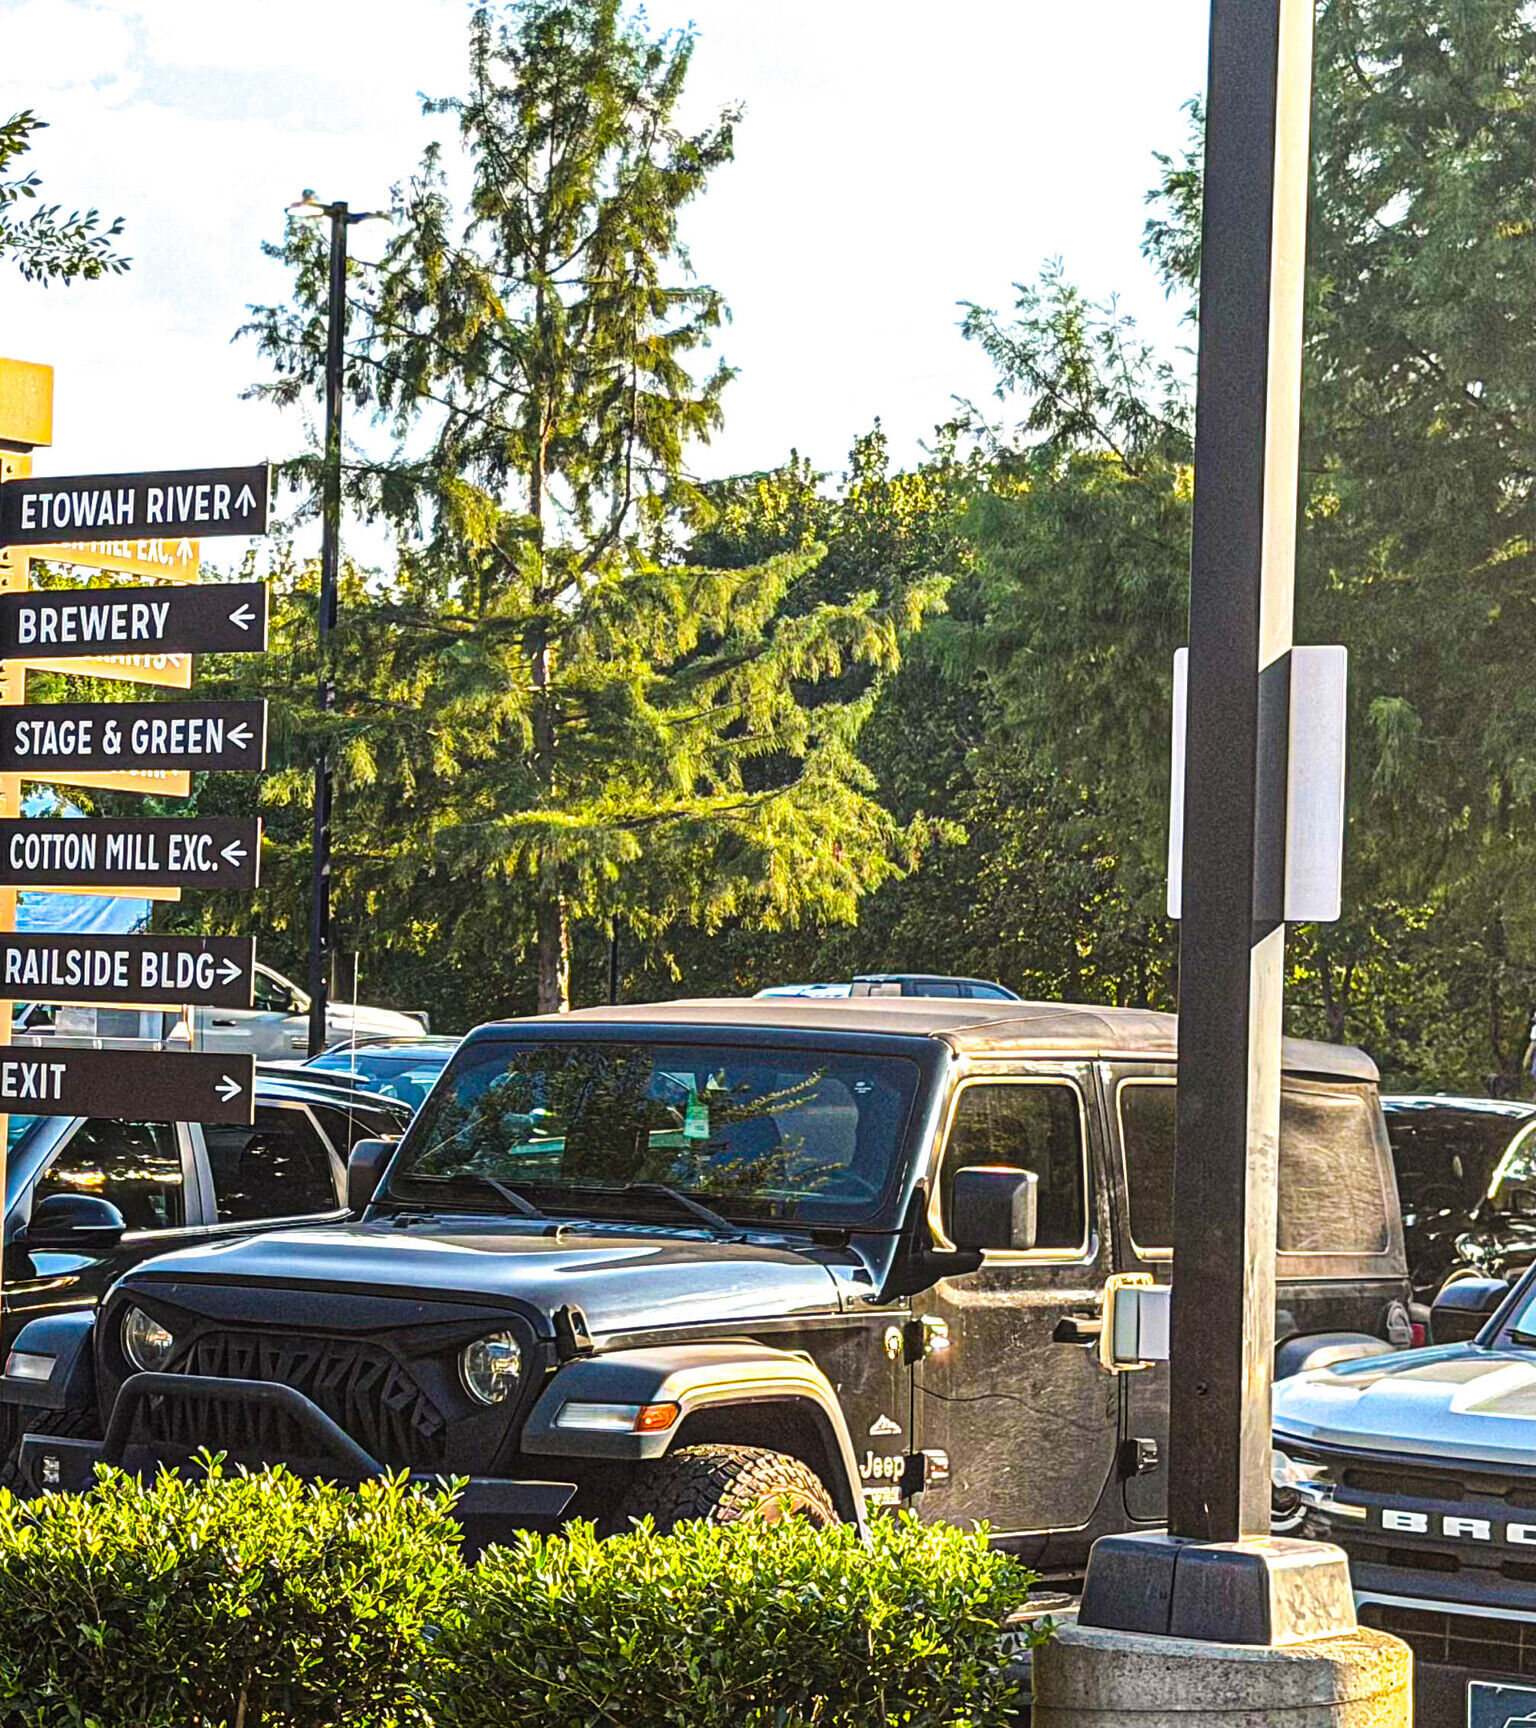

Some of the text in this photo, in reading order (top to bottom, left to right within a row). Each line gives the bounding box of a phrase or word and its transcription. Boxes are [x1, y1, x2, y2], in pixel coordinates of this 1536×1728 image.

[21, 484, 231, 529] ETOWAH RIVER
[18, 602, 170, 644] BREWERY
[15, 718, 224, 756] STAGE & GREEN
[9, 833, 219, 872] COTTON MILL EXC.
[5, 948, 215, 990] RAILSIDE BLDG
[1, 1062, 66, 1100] EXIT
[858, 1450, 905, 1482] Jeep
